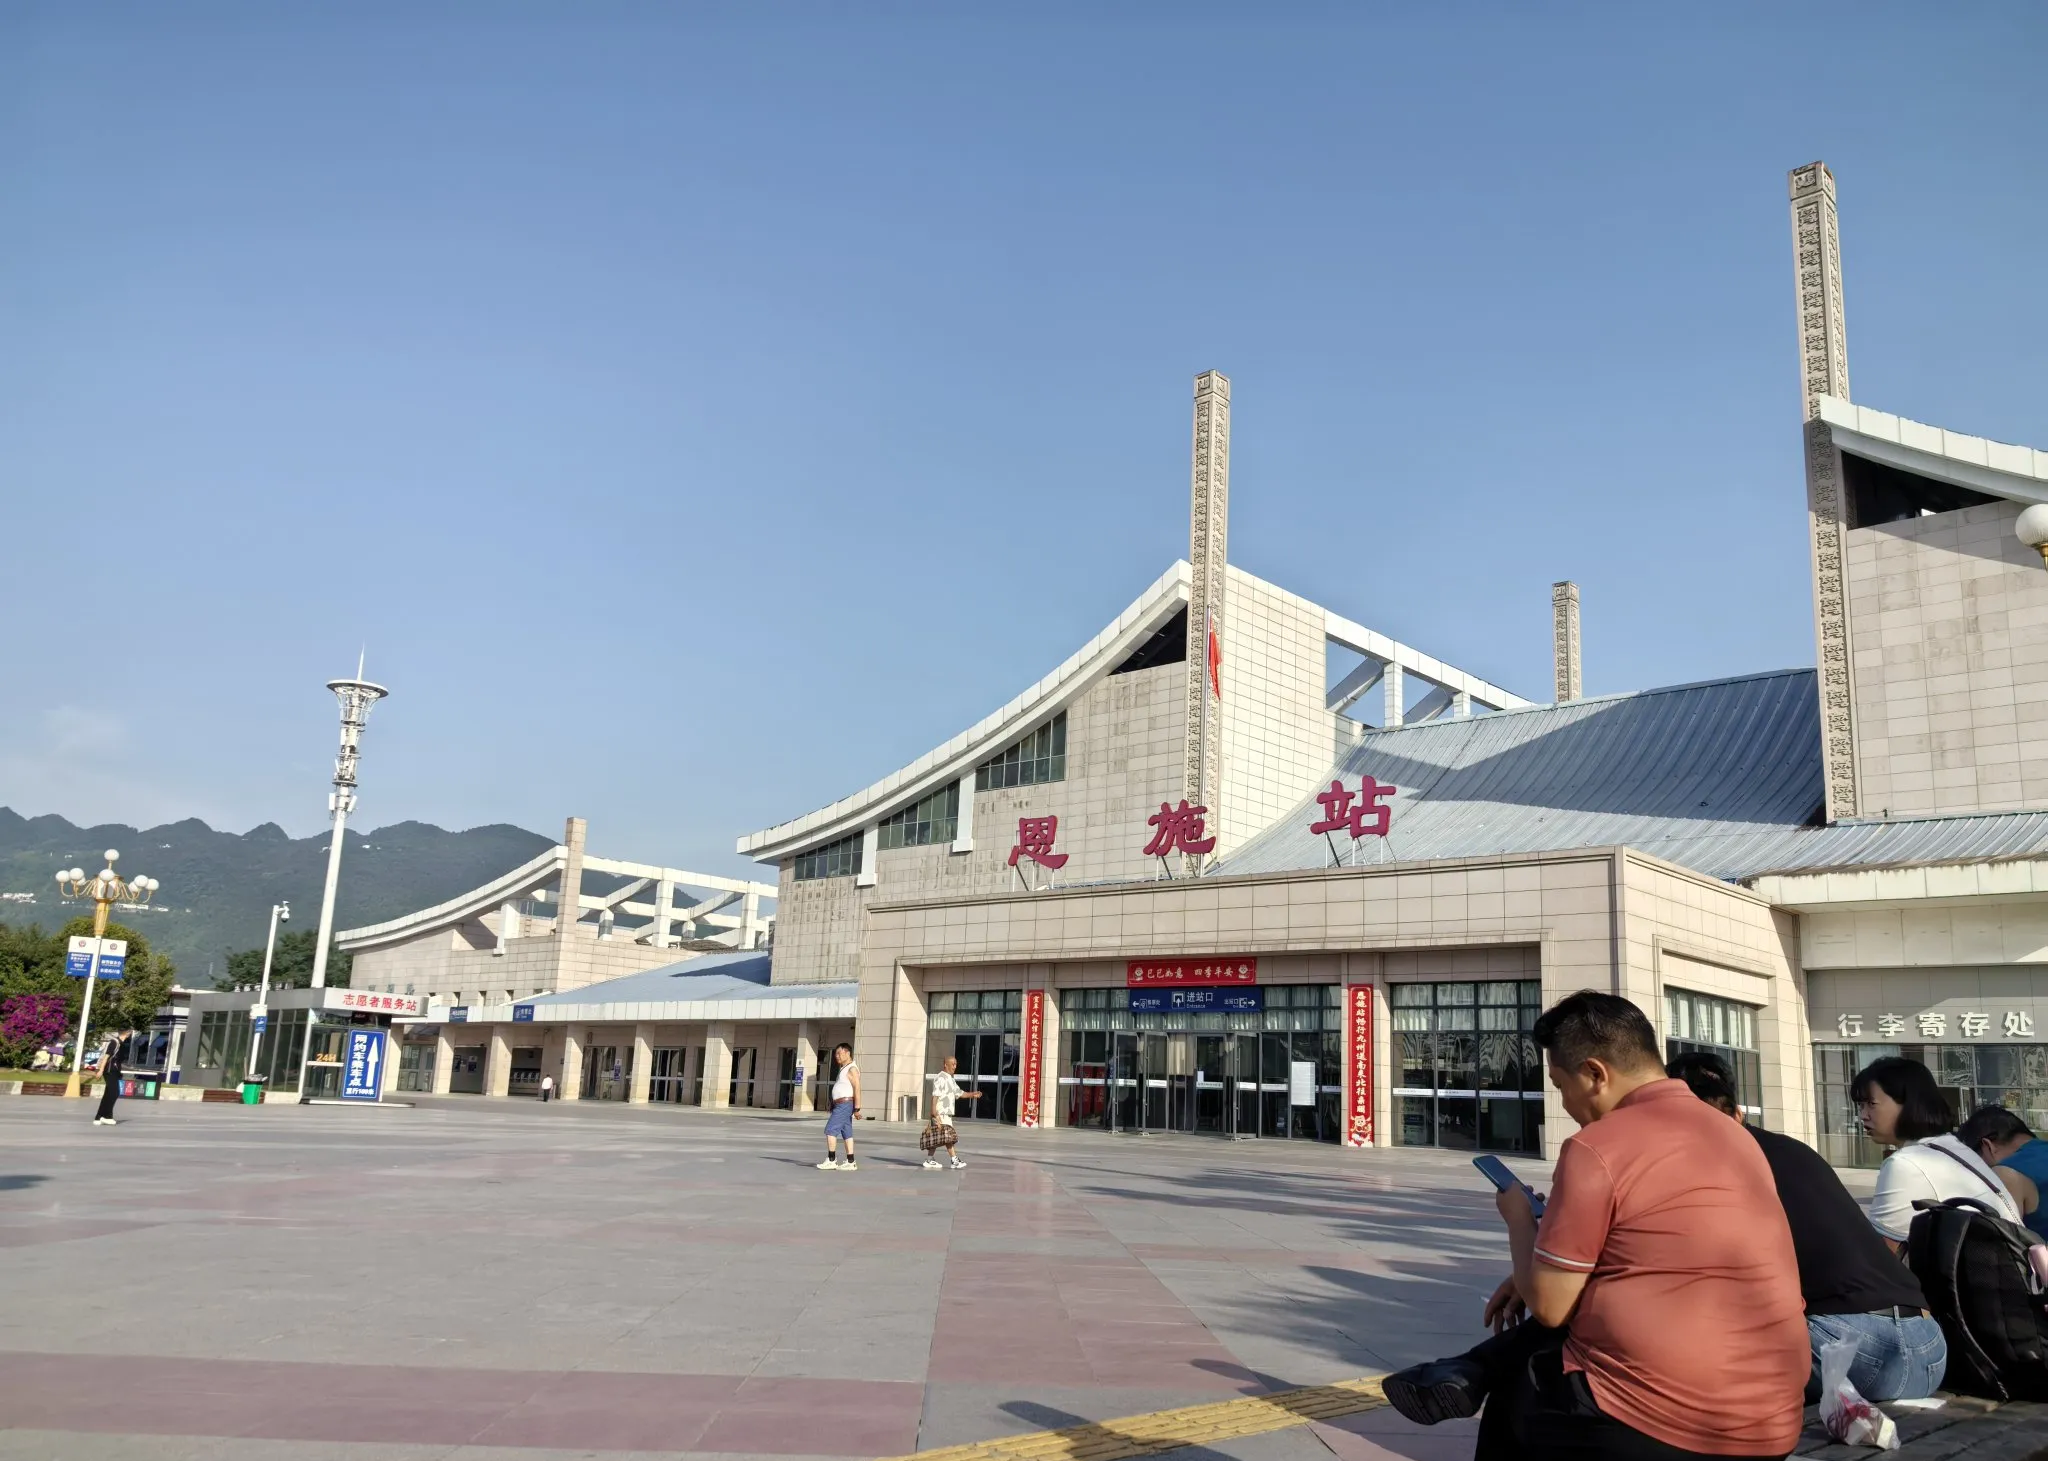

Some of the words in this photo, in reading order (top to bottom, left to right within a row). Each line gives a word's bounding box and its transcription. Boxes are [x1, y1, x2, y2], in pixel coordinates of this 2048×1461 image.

[1008, 775, 1396, 869] 恩施站
[1194, 966, 1234, 979] 四季平安
[343, 994, 418, 1012] 志愿者服务站
[1187, 992, 1213, 1003] 进站口
[1838, 1011, 2034, 1037] 行李寄存处
[316, 1053, 337, 1062] 24H
[348, 1035, 368, 1087] 网约车乘车点
